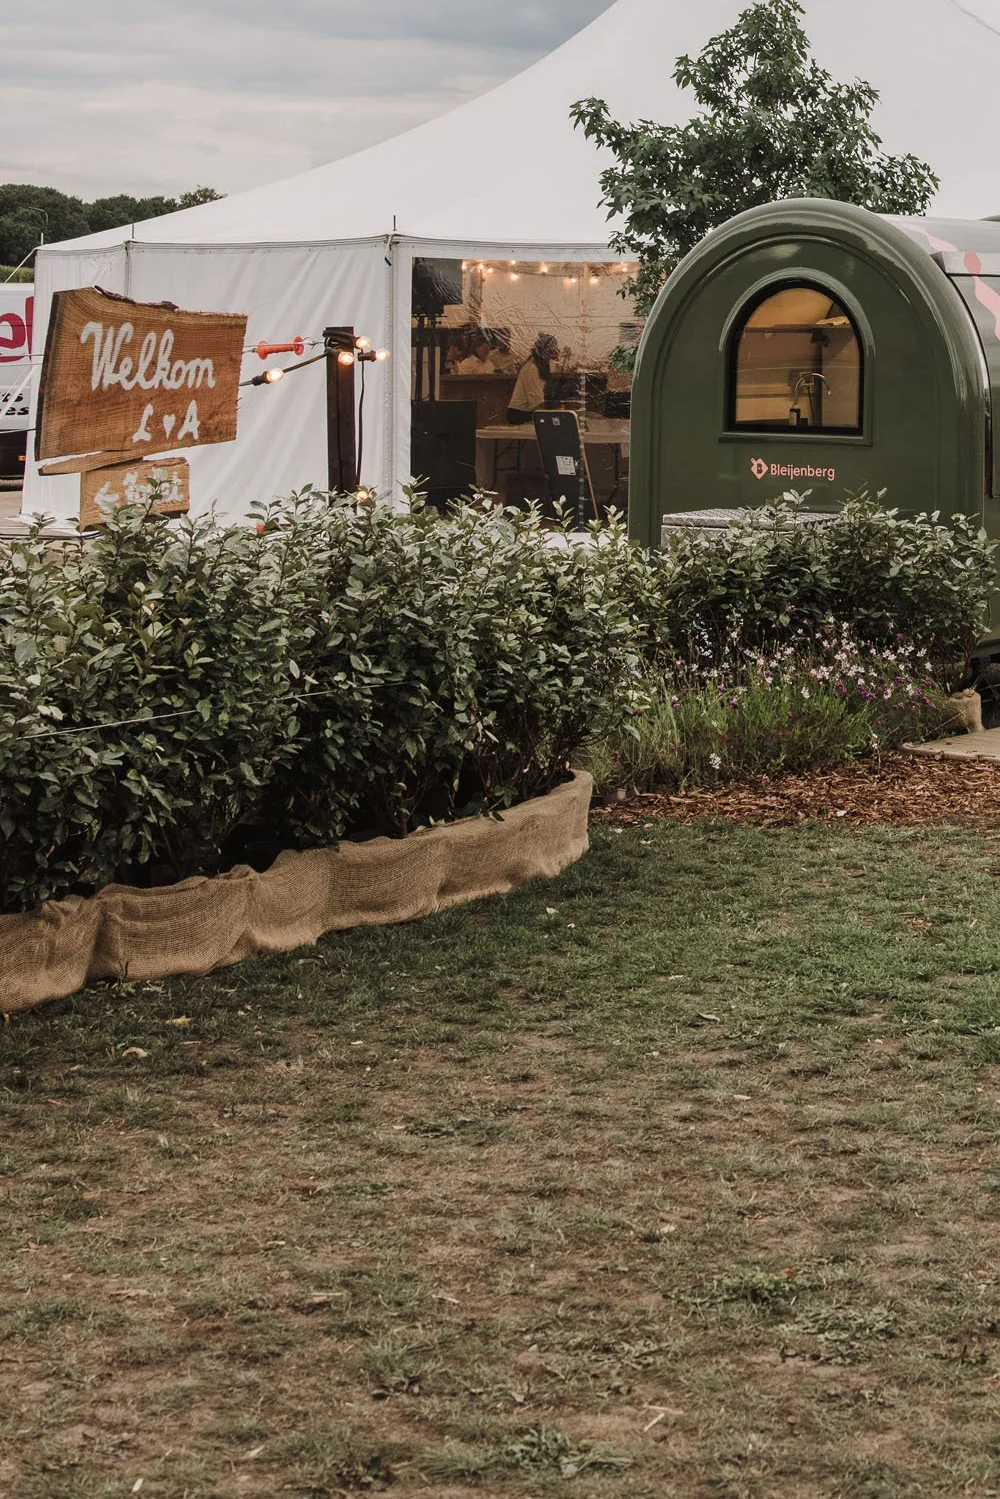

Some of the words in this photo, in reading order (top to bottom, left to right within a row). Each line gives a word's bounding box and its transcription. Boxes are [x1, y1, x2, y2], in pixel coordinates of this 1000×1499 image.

[80, 322, 216, 391] Welkom
[132, 404, 153, 443] L
[177, 400, 200, 440] A
[770, 463, 835, 481] Bleijenberg
